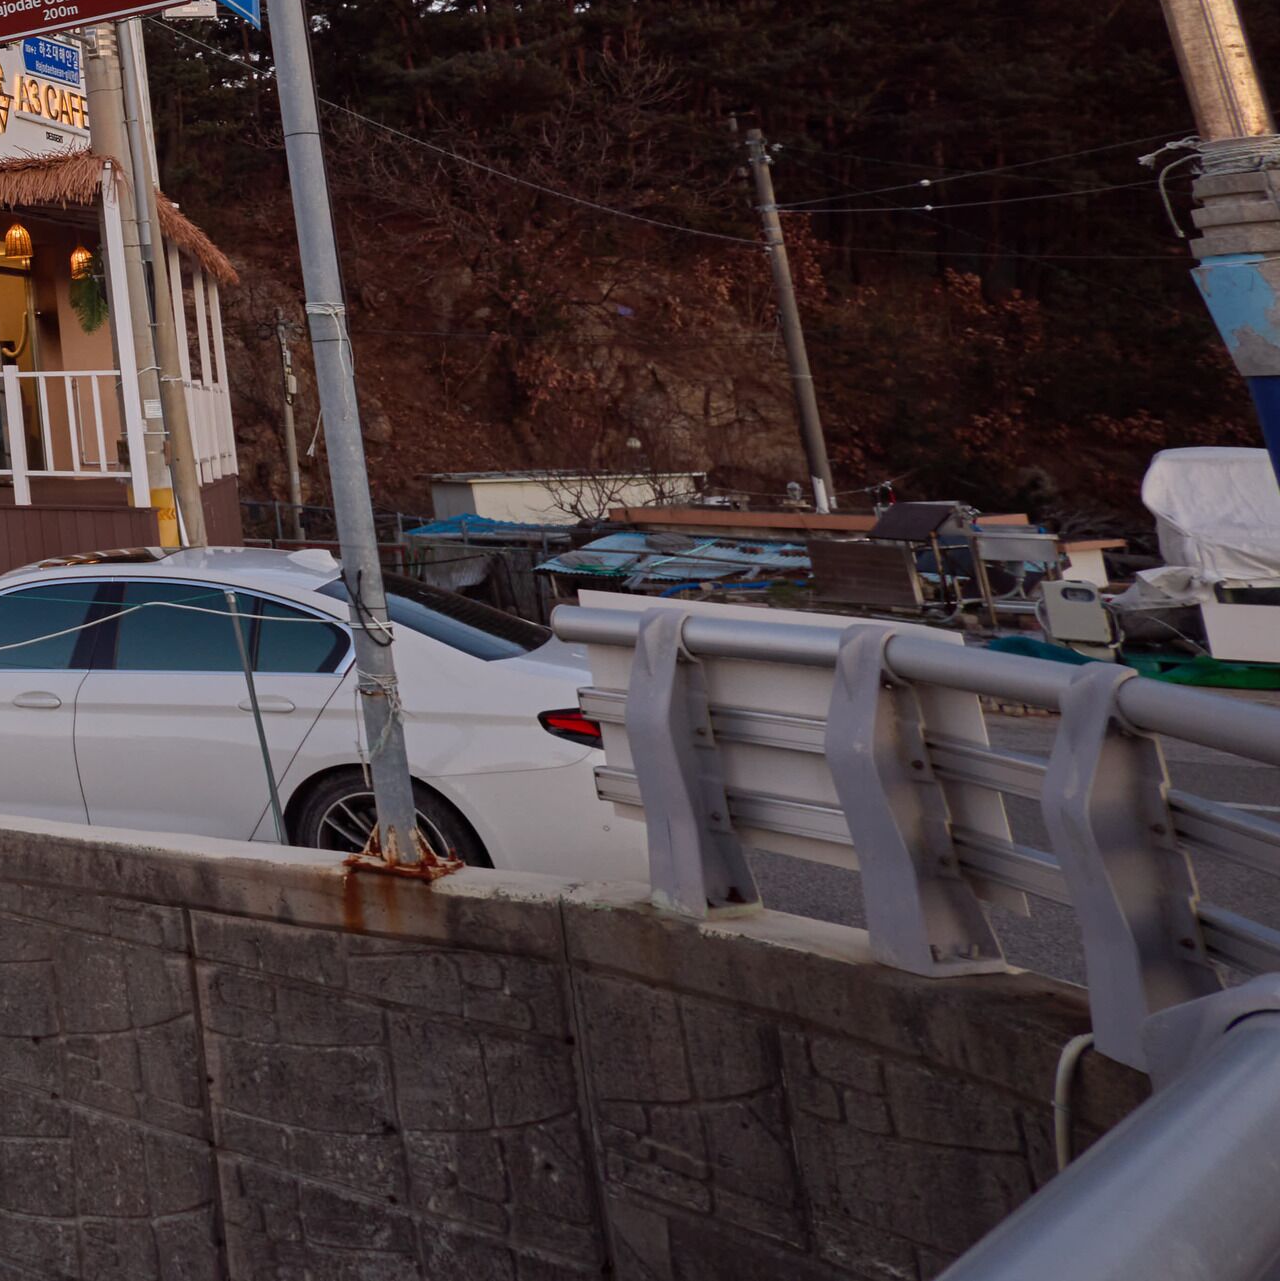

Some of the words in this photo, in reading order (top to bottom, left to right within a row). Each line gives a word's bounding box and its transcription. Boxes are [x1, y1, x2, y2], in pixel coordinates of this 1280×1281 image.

[42, 4, 79, 21] 200m
[39, 40, 79, 70] 하조대해안길
[14, 74, 42, 116] A3
